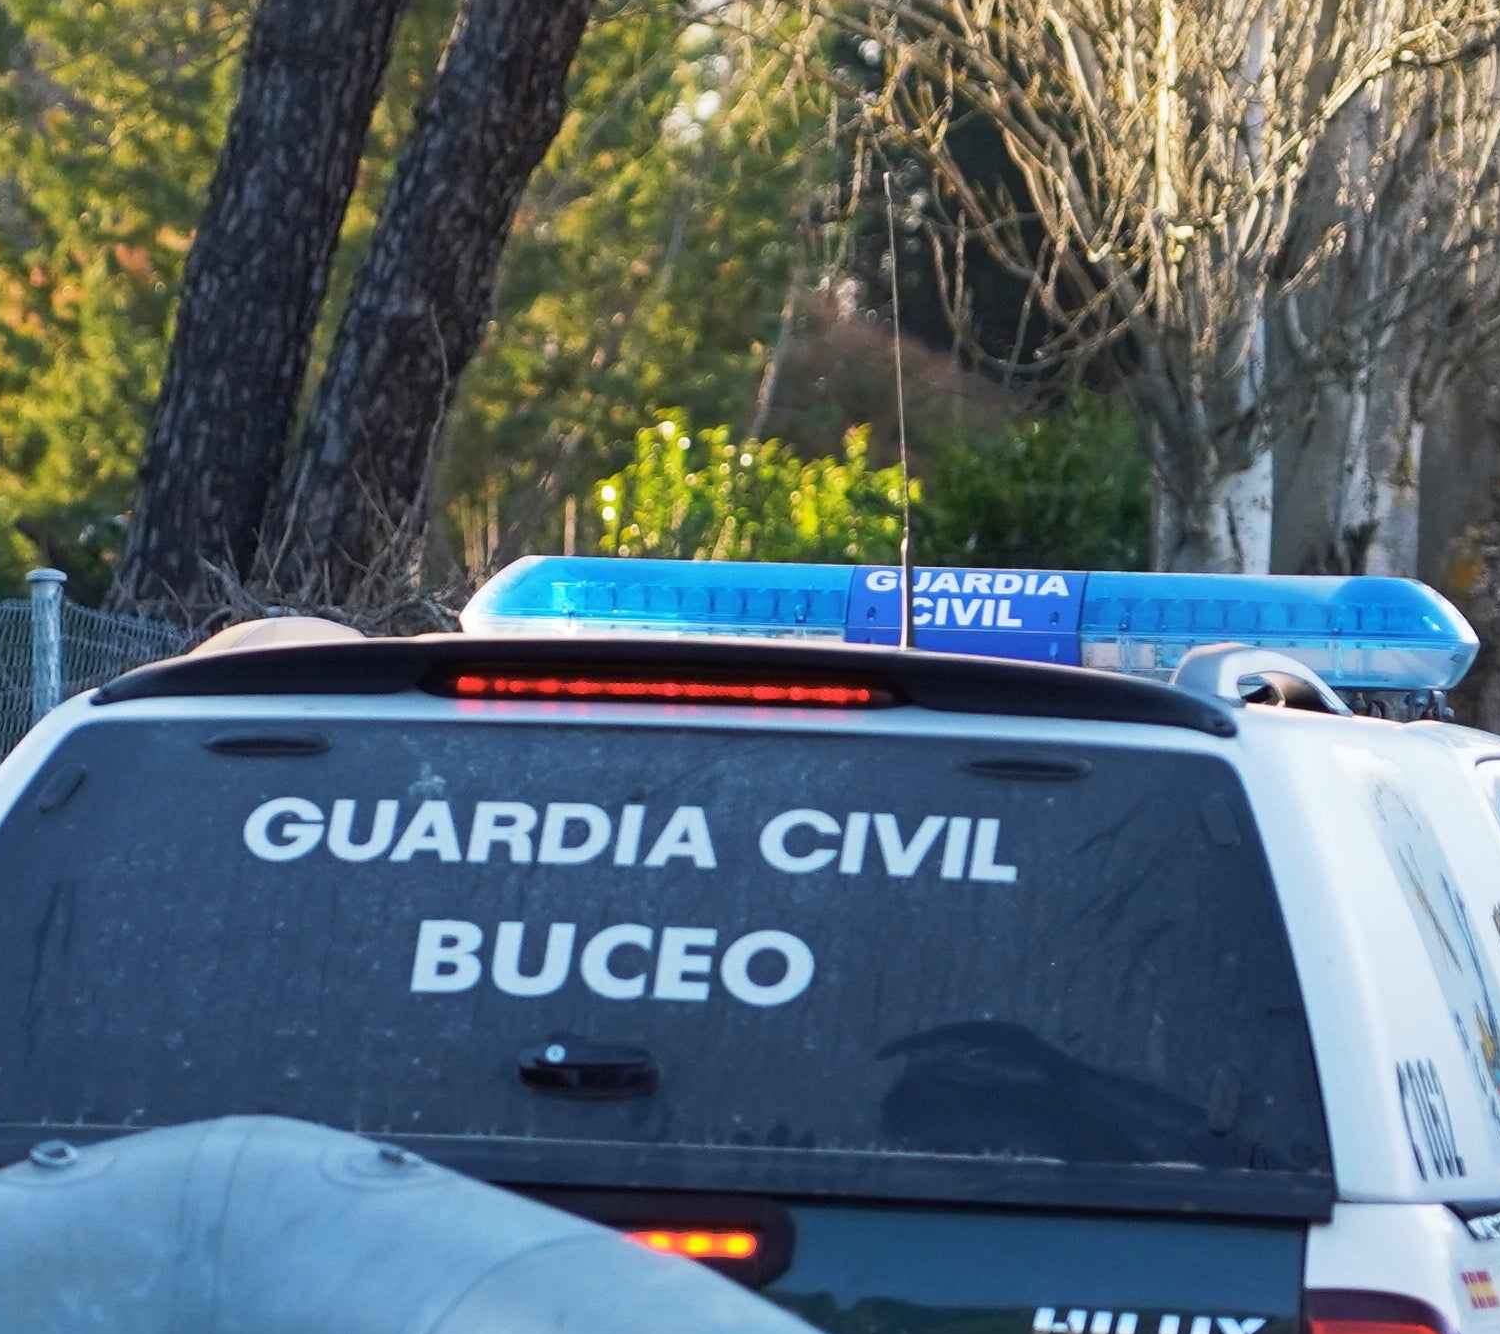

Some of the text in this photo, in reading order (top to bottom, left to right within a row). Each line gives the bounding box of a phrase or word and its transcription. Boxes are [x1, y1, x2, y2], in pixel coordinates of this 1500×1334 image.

[865, 570, 1070, 597] GUARDIA
[911, 596, 1023, 628] CIVIL
[242, 795, 1019, 884] GUARDIA CIVIL
[409, 918, 816, 1008] BUCEO
